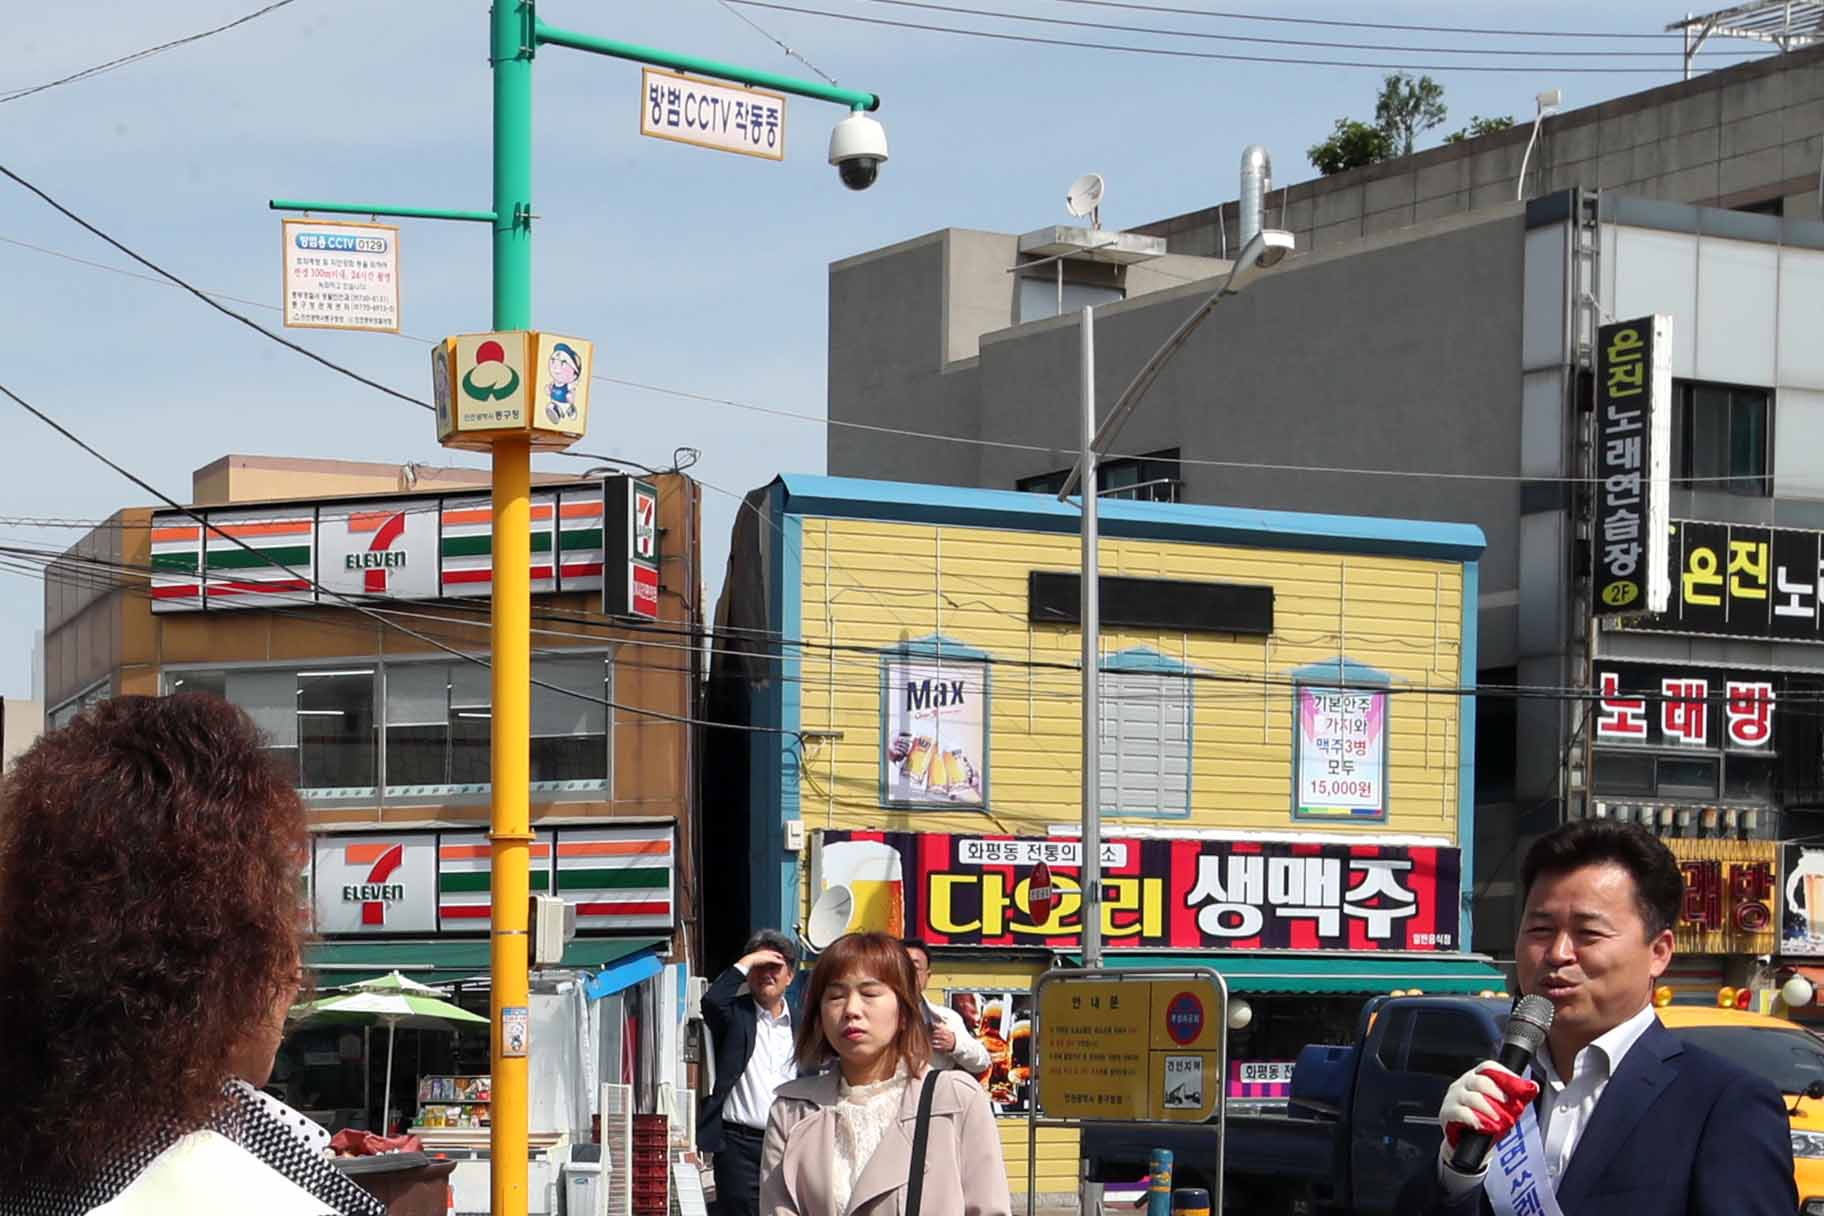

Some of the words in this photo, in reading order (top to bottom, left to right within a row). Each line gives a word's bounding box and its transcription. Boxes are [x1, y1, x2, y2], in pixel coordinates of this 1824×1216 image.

[650, 83, 681, 127] 방범
[685, 92, 731, 133] CCTV
[736, 100, 778, 148] 작동중
[328, 237, 354, 249] CCTV
[358, 239, 383, 250] 0129
[1604, 406, 1642, 576] 노래연습장
[348, 511, 405, 593] 7
[1611, 584, 1630, 603] 2F
[907, 679, 964, 712] Max
[1314, 695, 1370, 713] 기본안주
[1597, 673, 1776, 746] 노래방
[1328, 760, 1355, 776] 모두
[1311, 780, 1371, 798] 15,000원
[968, 843, 1018, 861] 화평동
[1026, 843, 1076, 862] 전통의
[345, 843, 403, 926] 7
[929, 874, 1163, 937] 다오리
[1187, 855, 1416, 938] 생맥주
[1681, 860, 1776, 931] 래방
[1167, 1061, 1201, 1073] 견인지역
[1246, 1064, 1279, 1080] 화평동
